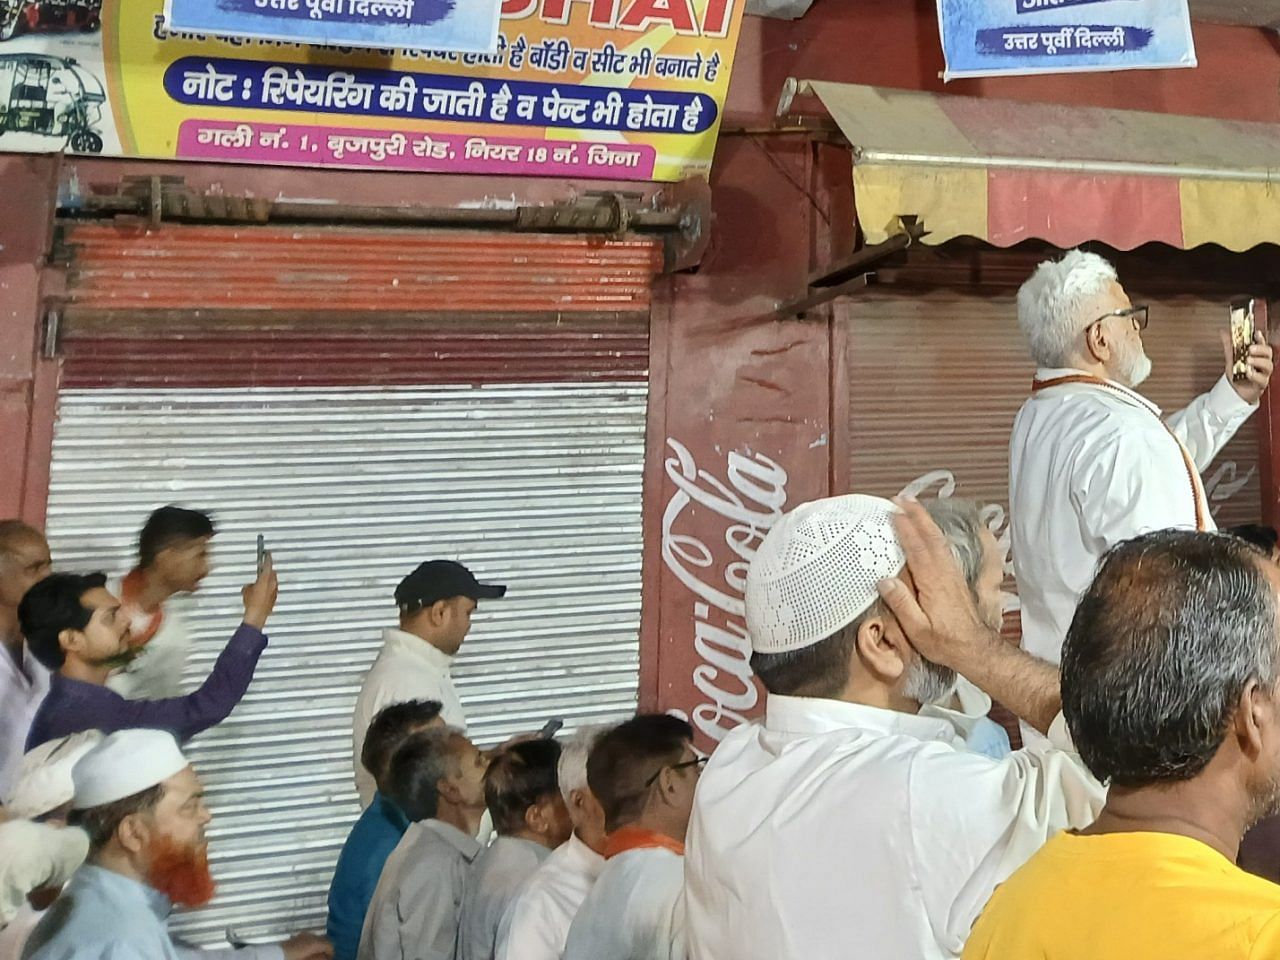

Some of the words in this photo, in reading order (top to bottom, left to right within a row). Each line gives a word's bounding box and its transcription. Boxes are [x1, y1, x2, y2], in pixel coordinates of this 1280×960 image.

[509, 34, 526, 68] है
[530, 40, 568, 71] बॉडी
[573, 49, 588, 70] व
[591, 42, 625, 74] सीट
[628, 47, 651, 76] भी
[655, 51, 702, 79] बनाते
[705, 52, 721, 82] है
[1003, 32, 1039, 50] उत्तर
[1040, 28, 1075, 53] पूर्वी
[1073, 27, 1125, 48] दिल्ली
[182, 63, 237, 100] नोट
[261, 65, 374, 111] रिपेयरिंग
[379, 75, 415, 112] की
[422, 81, 486, 117] जाती
[489, 83, 511, 123] है
[517, 93, 537, 120] व
[542, 89, 590, 124] पेन्ट
[592, 92, 623, 125] भी
[628, 95, 679, 129] होता
[682, 96, 703, 132] है
[198, 124, 253, 148] गली
[327, 134, 407, 161] बृजपुरी
[465, 139, 522, 162] नियर
[527, 147, 546, 163] 18
